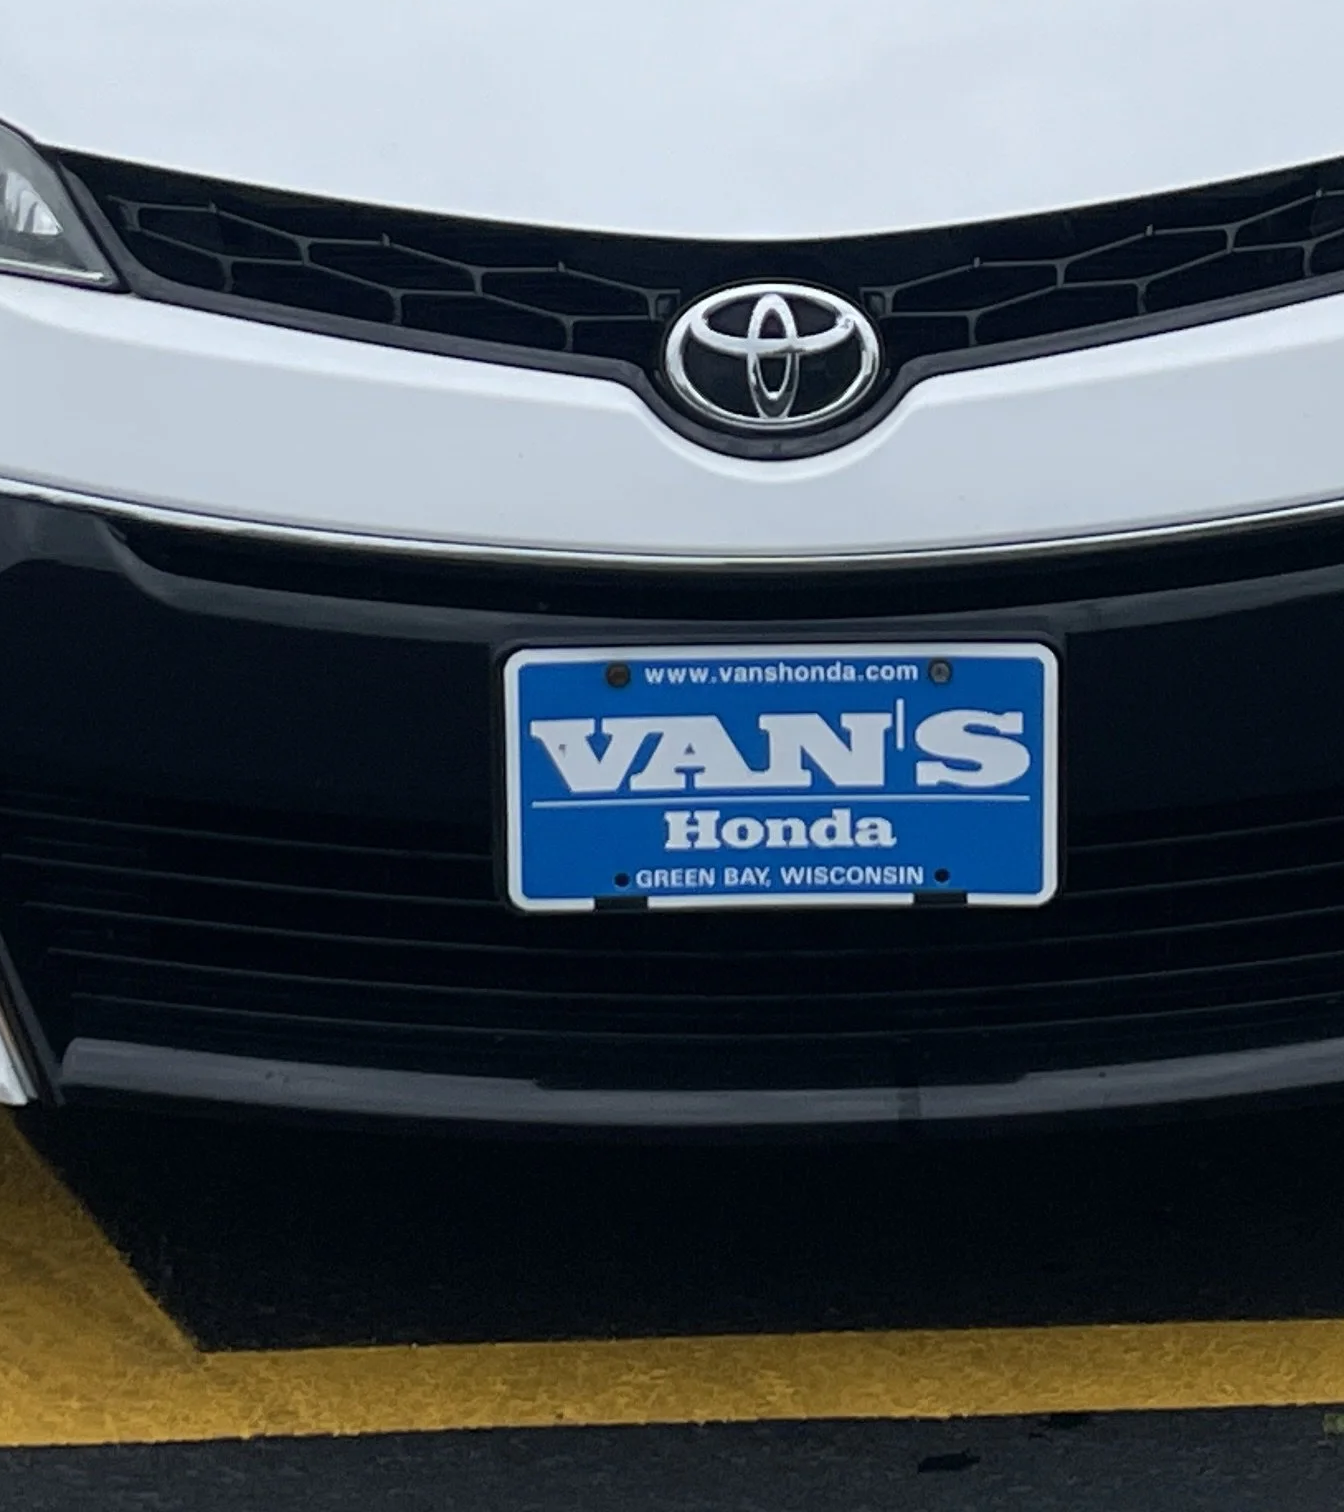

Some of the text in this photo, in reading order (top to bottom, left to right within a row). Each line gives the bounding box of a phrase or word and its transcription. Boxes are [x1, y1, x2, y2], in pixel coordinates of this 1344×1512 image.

[644, 661, 919, 684] www.vanshonda.com
[529, 698, 1032, 793] VAN'S
[663, 808, 898, 851] Honda
[635, 865, 924, 889] GREEN BAY, WISCONSIN
